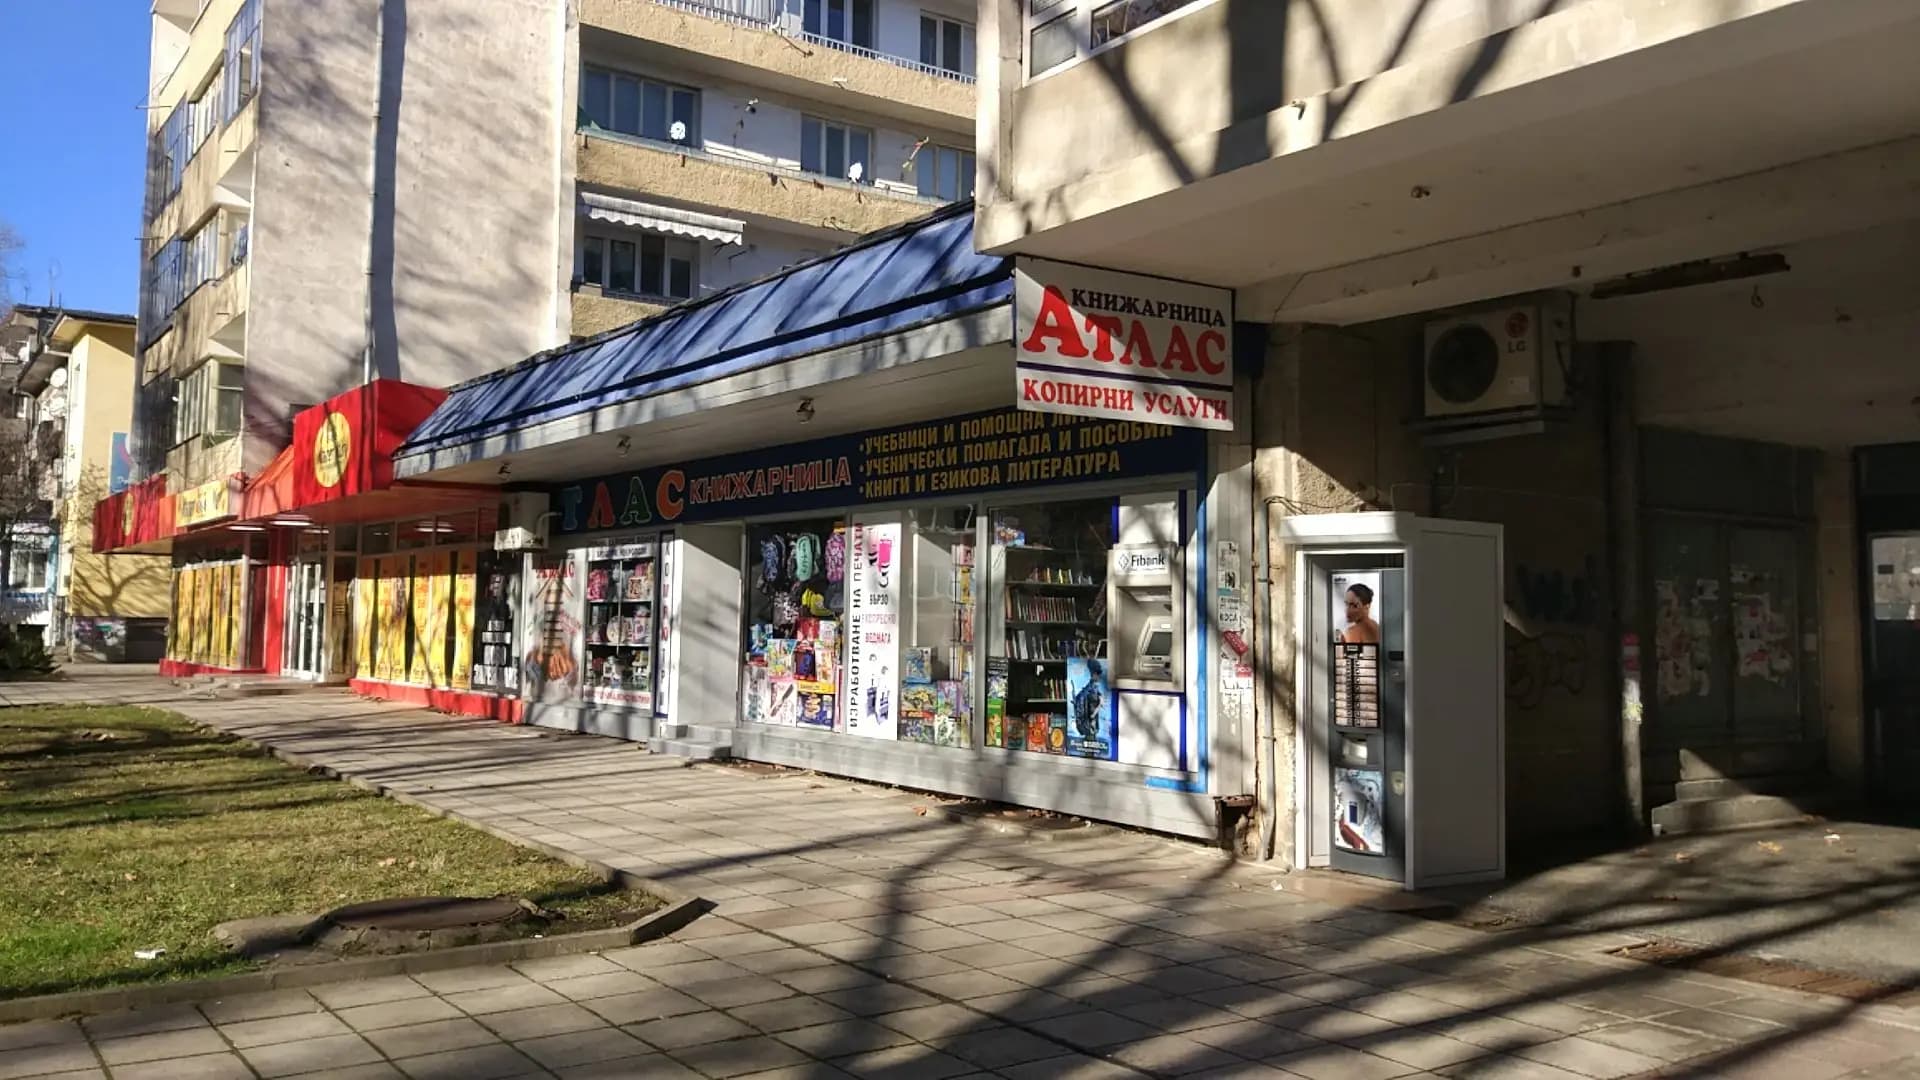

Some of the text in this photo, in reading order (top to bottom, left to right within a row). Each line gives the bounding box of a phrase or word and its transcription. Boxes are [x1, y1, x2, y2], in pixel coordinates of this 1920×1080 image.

[1071, 288, 1226, 327] КНИЖАРНИЦА
[1022, 284, 1226, 376] АТЛАС
[1507, 341, 1527, 353] LG
[1023, 378, 1228, 421] КОПИРНИ УСЛУГИ
[864, 428, 938, 454] УЧЕБНИЦИ
[944, 424, 955, 443] И
[960, 411, 1045, 439] ПОМОЩНА
[864, 446, 957, 477] УЧЕНИЧЕСКИ
[963, 435, 1051, 463] ПОМАГАЛА
[1058, 431, 1071, 450] И
[560, 456, 852, 531] ТЛАС КНИЖАРНИЦА
[864, 450, 1121, 499] КНИГИ И ЕЗИКОВА ЛИТЕРАТУРА
[1131, 553, 1165, 567] Fibank
[849, 523, 864, 728] ИЗРАБОТВАНЕ НА ПЕЧАТИ
